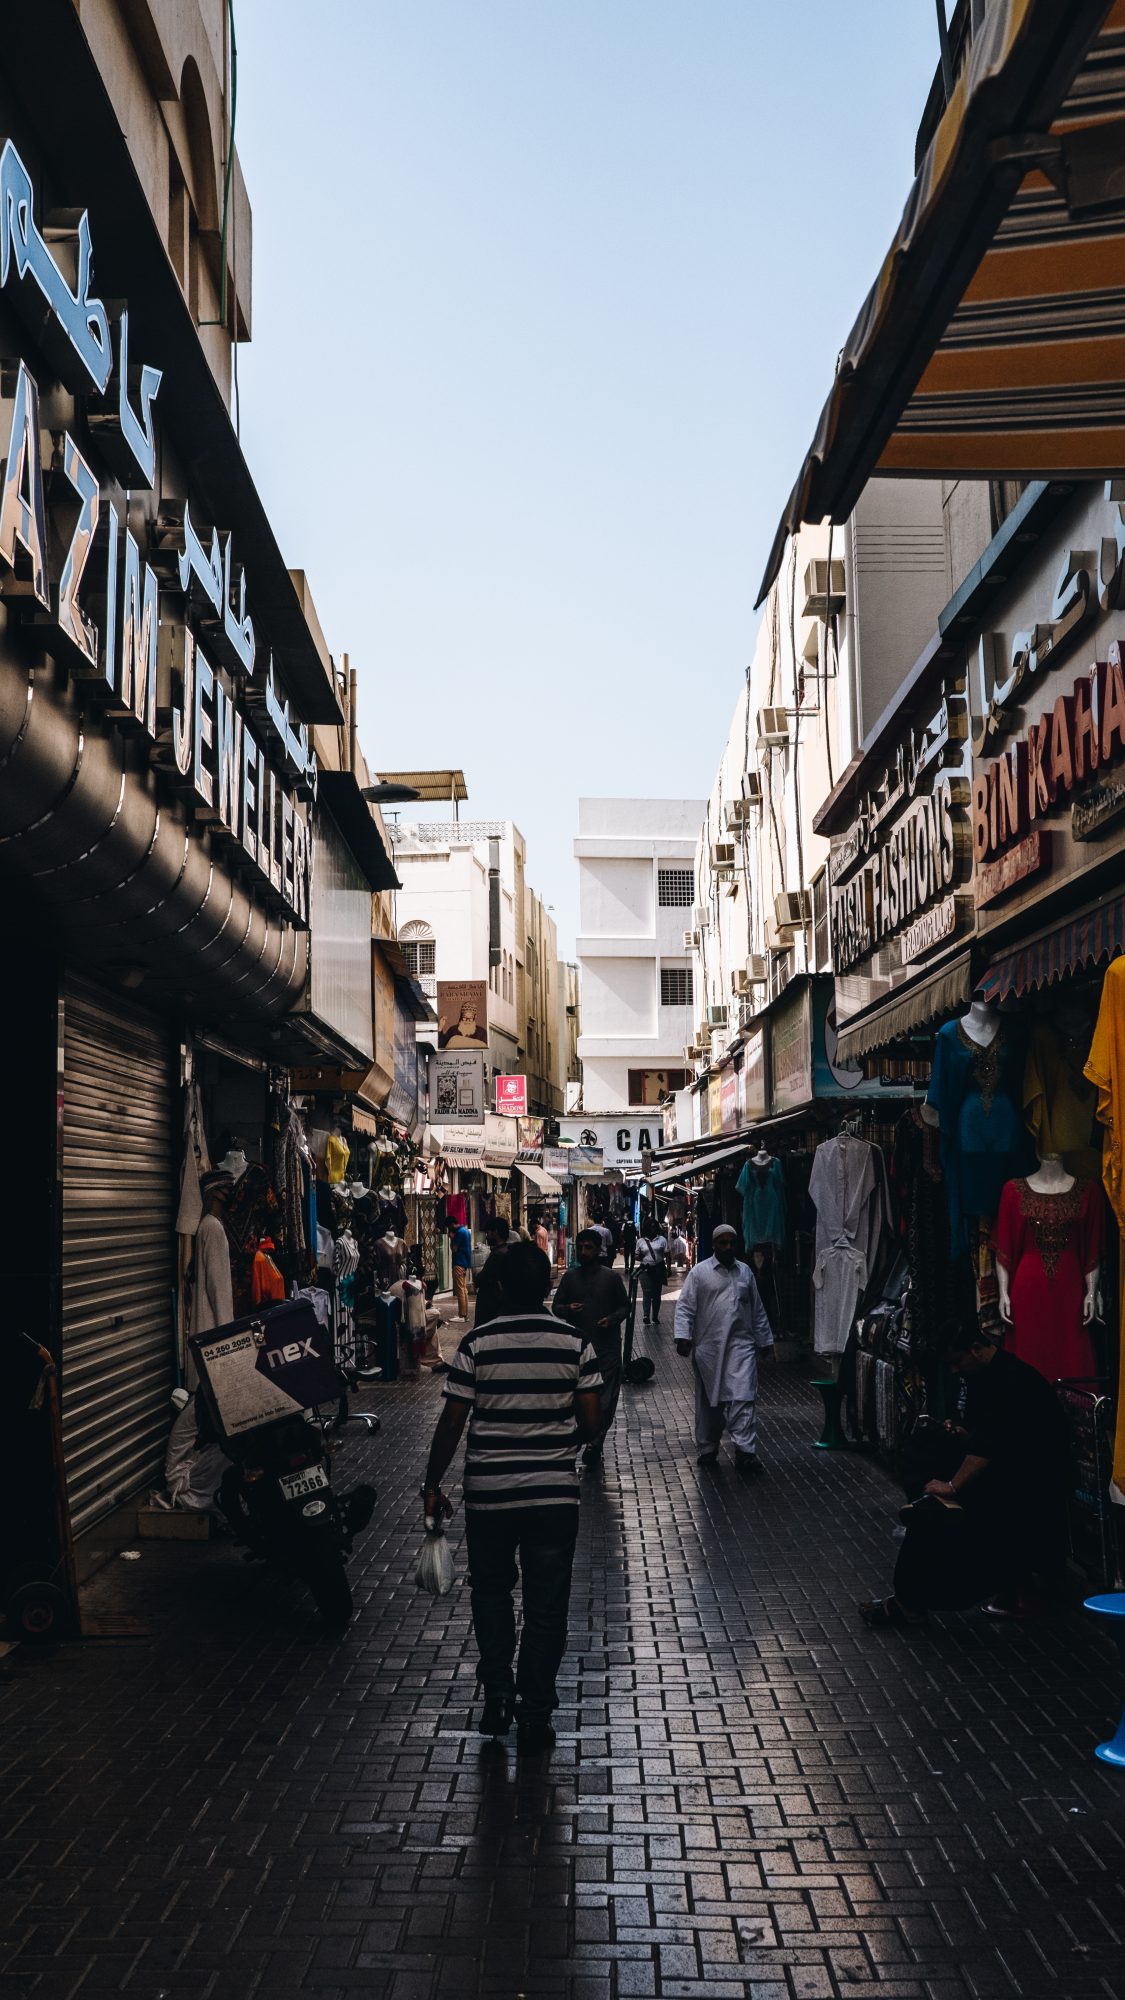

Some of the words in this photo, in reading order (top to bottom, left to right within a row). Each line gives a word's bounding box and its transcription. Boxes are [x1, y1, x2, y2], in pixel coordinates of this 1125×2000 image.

[973, 741, 1019, 863] BIN
[872, 776, 957, 943] FASHIONS
[204, 1349, 214, 1357] 04
[216, 1343, 231, 1354] 250
[232, 1336, 251, 1348] 2050
[266, 1336, 321, 1370] nex
[286, 1475, 323, 1497] 72366
